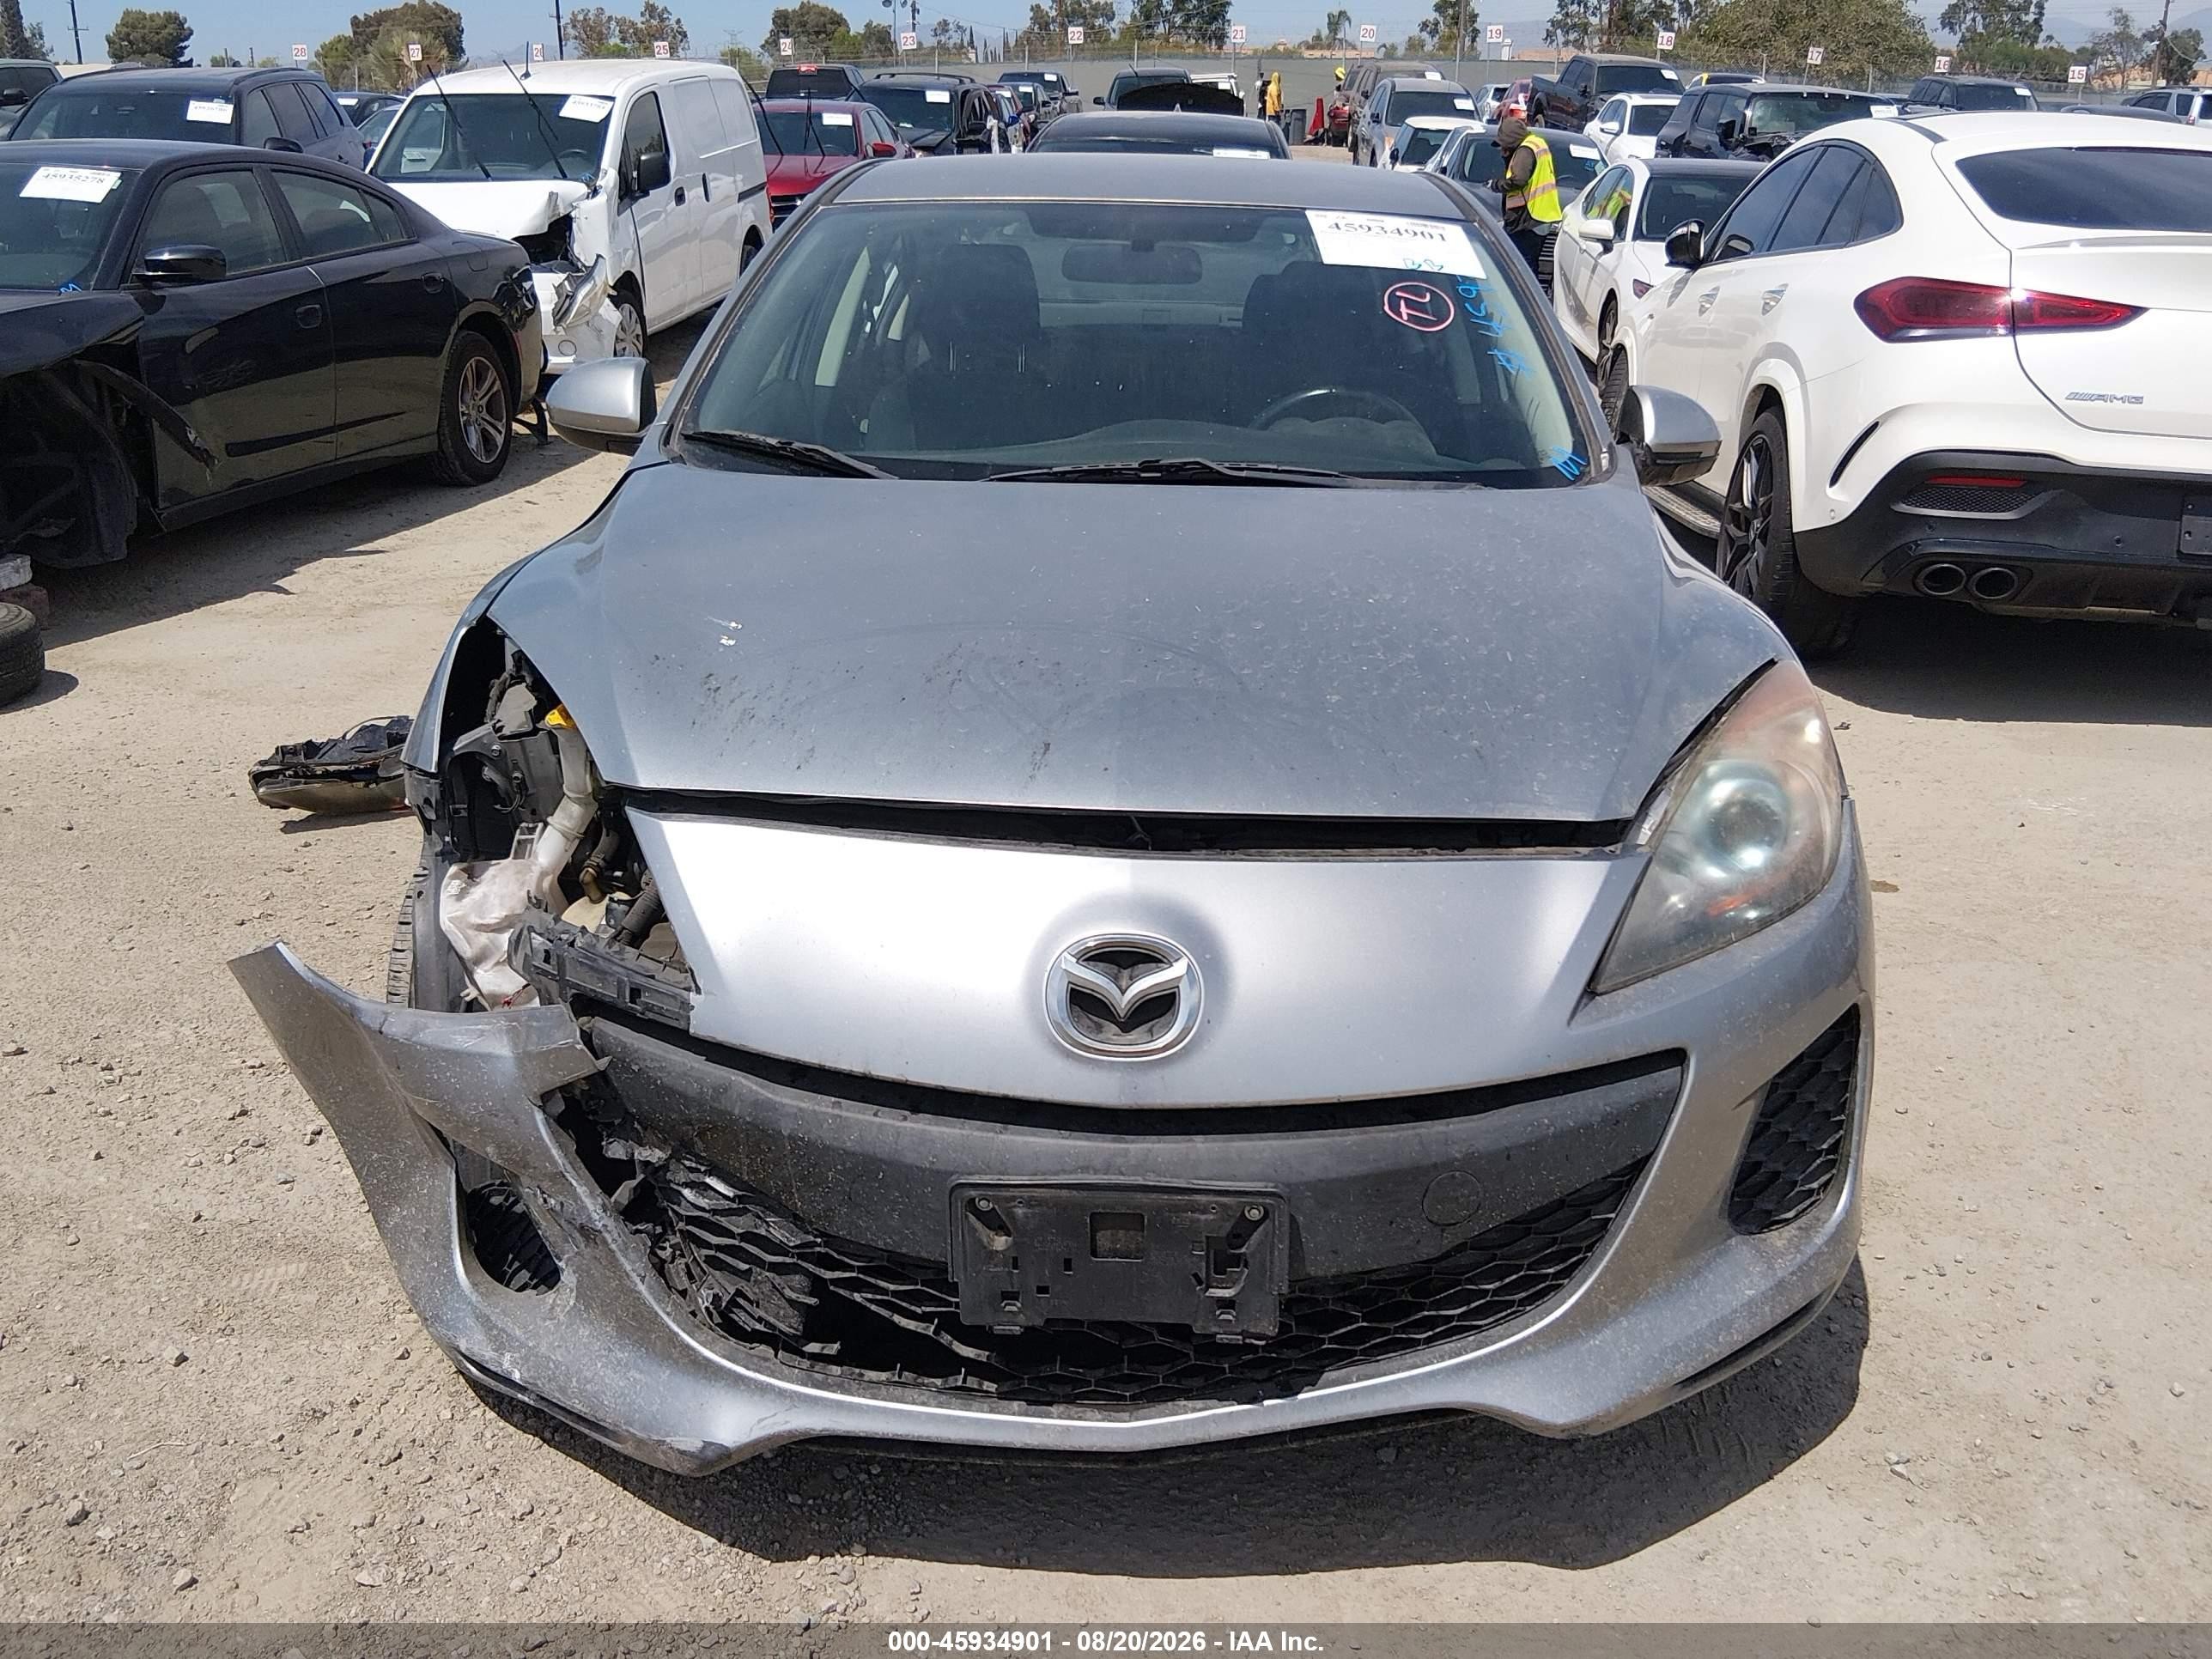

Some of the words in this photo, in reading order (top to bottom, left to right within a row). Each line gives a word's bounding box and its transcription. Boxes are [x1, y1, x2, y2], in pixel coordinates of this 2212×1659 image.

[1070, 31, 1082, 40] 22
[1232, 29, 1244, 40] 21
[1361, 28, 1374, 39] 20
[1489, 28, 1502, 39] 19
[902, 36, 915, 46] 23
[1659, 36, 1673, 46] 18
[294, 47, 307, 58] 28
[410, 48, 420, 58] 27
[656, 45, 668, 55] 25
[1810, 51, 1821, 61] 17
[1936, 59, 1948, 70] 16
[2069, 70, 2084, 80] 15
[1328, 222, 1447, 242] 45934901
